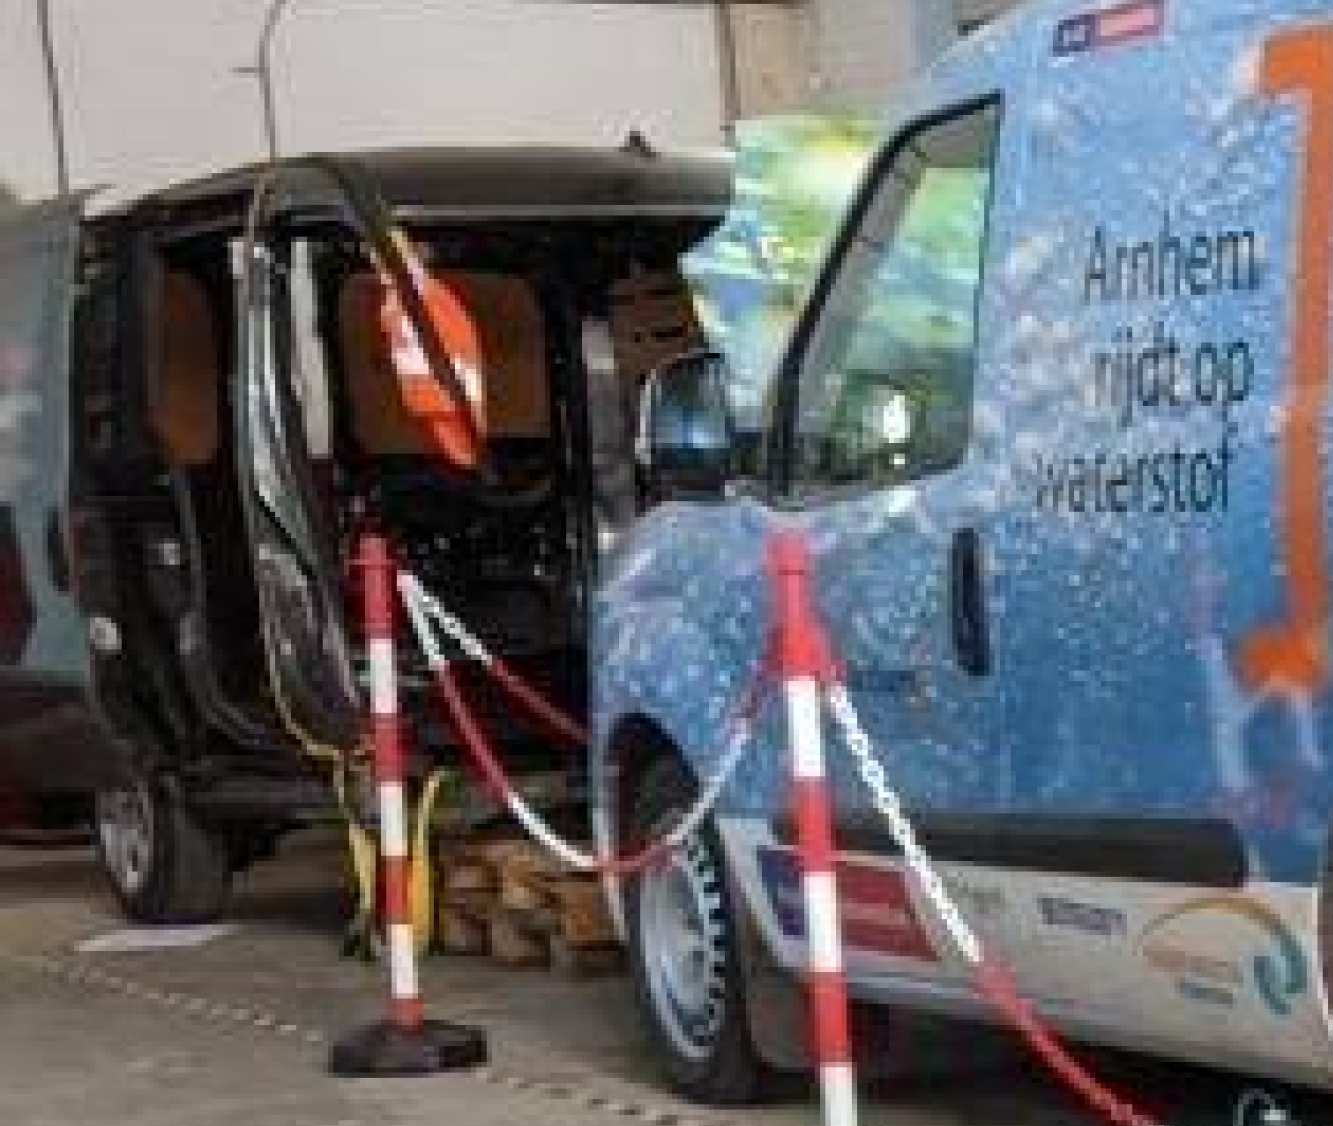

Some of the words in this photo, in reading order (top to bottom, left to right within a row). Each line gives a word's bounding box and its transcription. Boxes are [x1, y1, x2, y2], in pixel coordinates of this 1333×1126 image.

[1084, 208, 1260, 304] Arnhem
[1090, 321, 1181, 428] rijdt
[1195, 338, 1255, 416] op
[1032, 425, 1236, 514] waterstof
